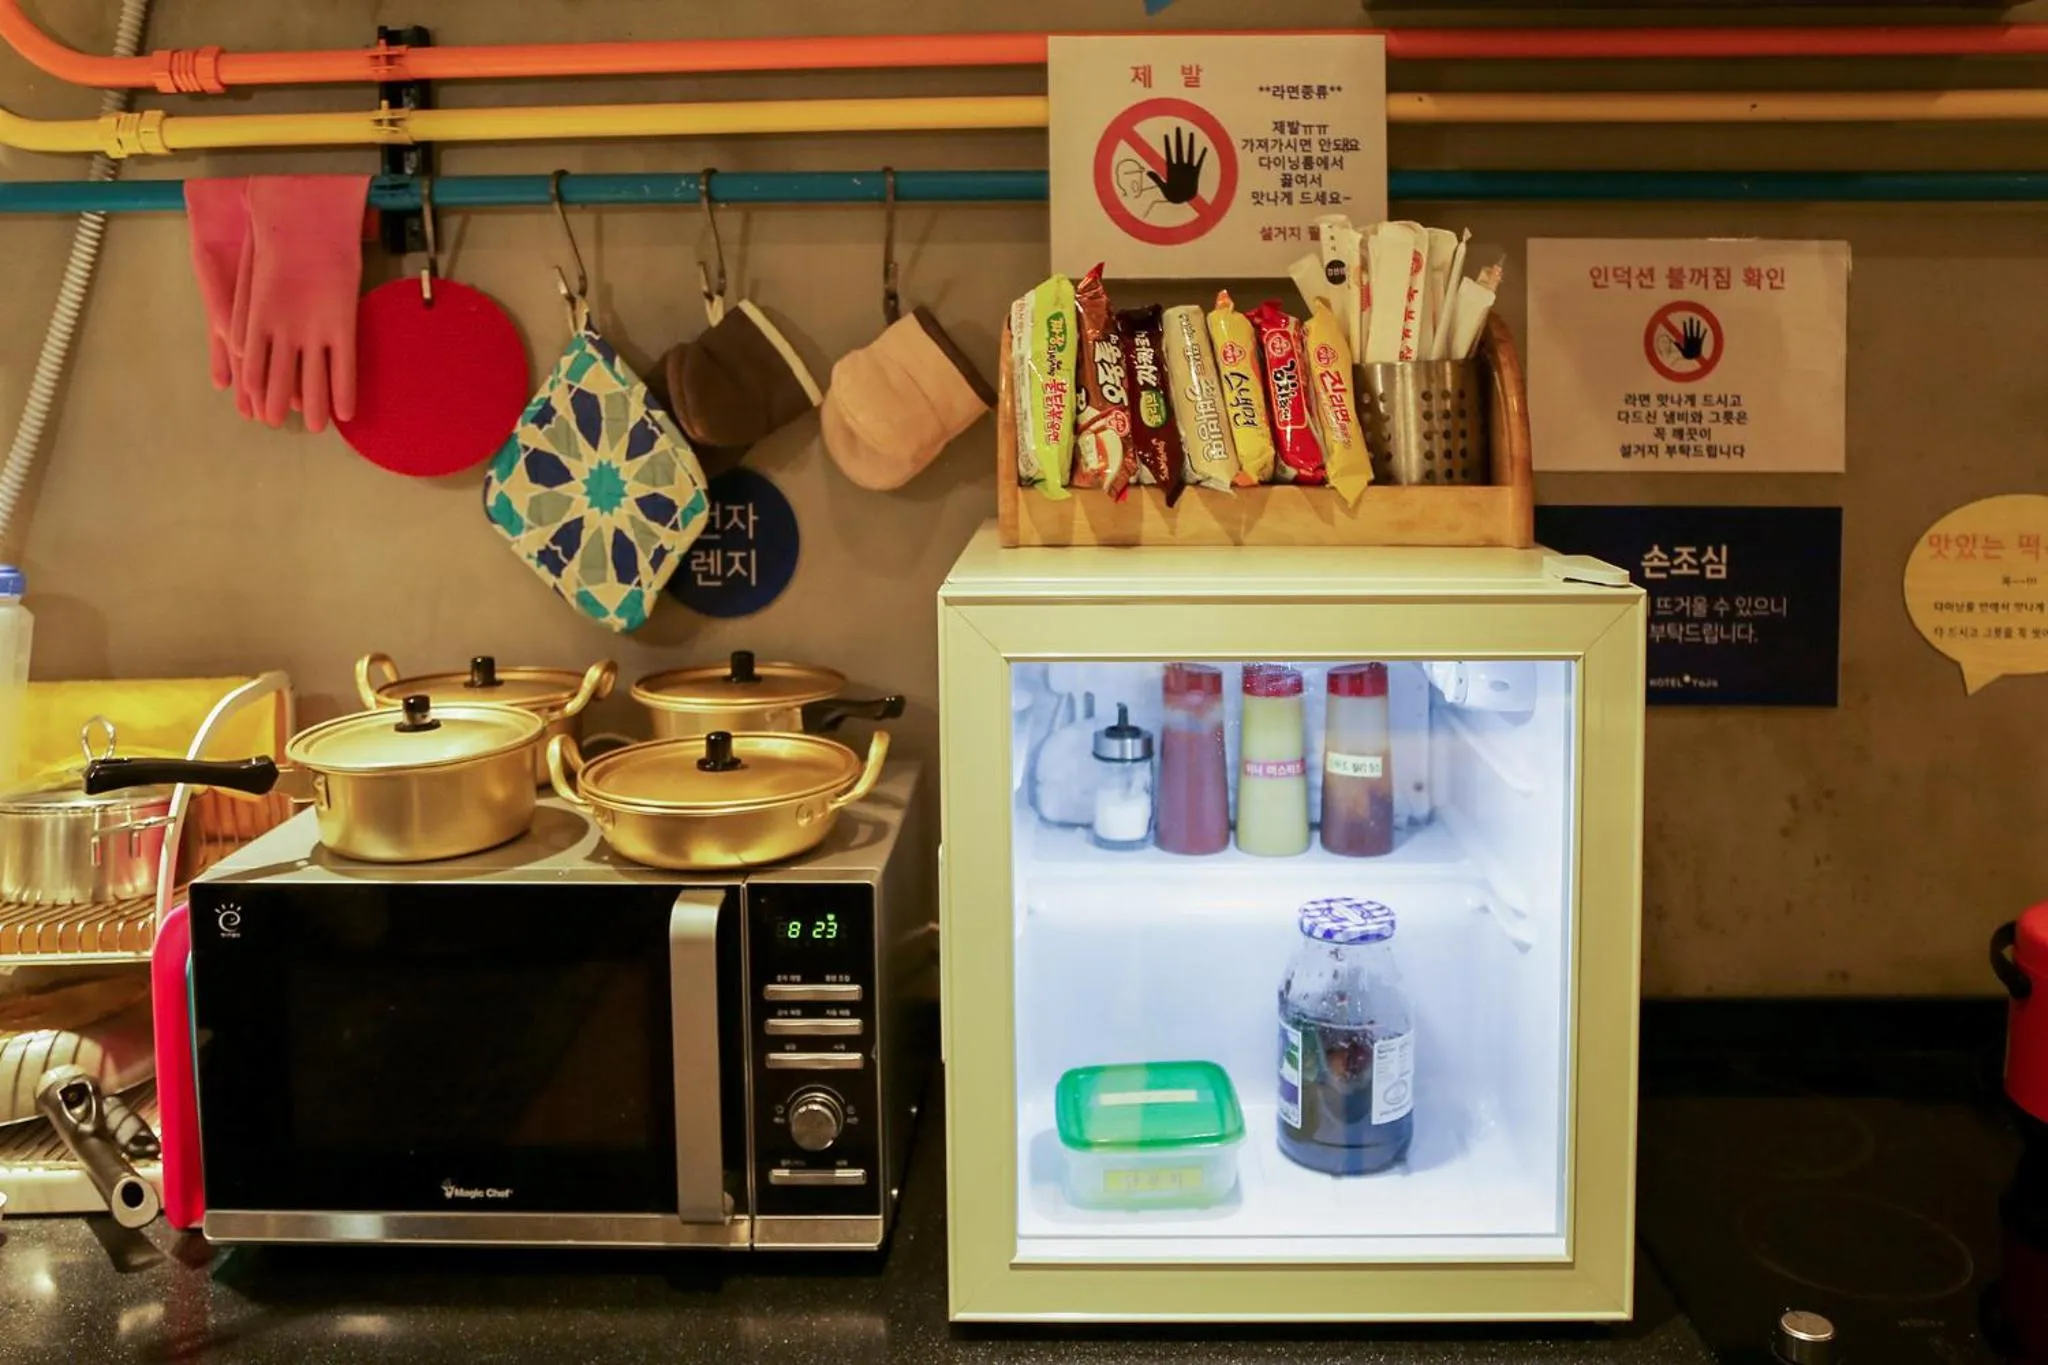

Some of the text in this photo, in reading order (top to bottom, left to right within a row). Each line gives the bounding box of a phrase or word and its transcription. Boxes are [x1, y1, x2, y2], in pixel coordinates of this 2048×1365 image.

[1130, 64, 1203, 88] 제 발
[1258, 155, 1344, 170] 다이닝룸에서
[1281, 173, 1322, 188] 끓여서
[1251, 191, 1293, 206] 맛나게
[1260, 225, 1301, 241] 설거지
[1589, 266, 1785, 290] 인덕션 불꺼짐 확인
[1224, 372, 1258, 427] 스낵면
[1319, 370, 1351, 422] 진라면
[1624, 393, 1742, 407] 라면 맛나게 드시고
[1617, 410, 1748, 425] 다드신 냄비와 그릇은
[1654, 427, 1711, 441] 꼭 깨끗이
[1620, 444, 1745, 458] 설거지 부탁드립니다
[1928, 533, 2048, 562] 맛있는 떡
[691, 549, 757, 587] 렌지
[1641, 544, 1727, 579] 손조심
[1655, 596, 1707, 618] 뜨거울
[1713, 596, 1730, 617] 수
[1735, 596, 1787, 618] 있으니
[1649, 622, 1759, 645] 부탁드립니다.
[787, 921, 838, 939] 8 23
[455, 1188, 509, 1199] Magic Chef
